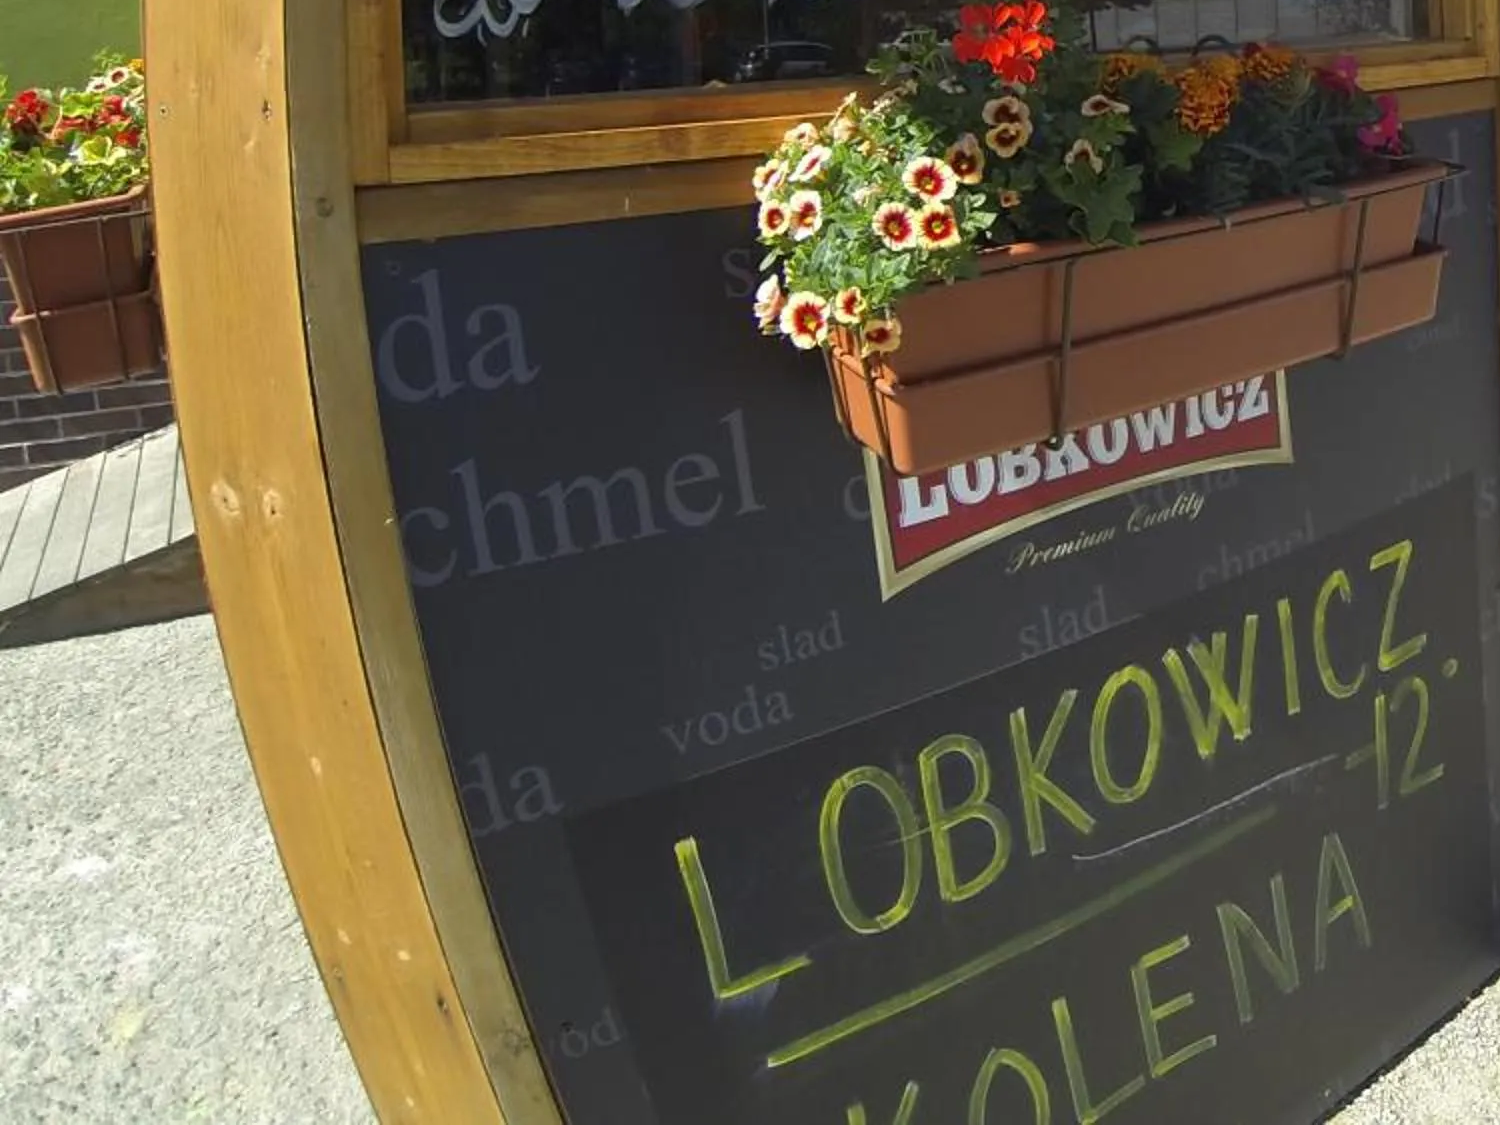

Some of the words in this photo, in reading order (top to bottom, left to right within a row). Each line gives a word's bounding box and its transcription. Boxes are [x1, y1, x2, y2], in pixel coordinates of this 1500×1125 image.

[400, 408, 765, 587] chmel
[1004, 530, 1116, 574] Premium
[1127, 489, 1206, 533] Quality
[756, 610, 846, 671] slad
[1018, 584, 1112, 659] slad
[660, 684, 795, 755] voda
[673, 538, 1428, 1000] LOBKOWICZ
